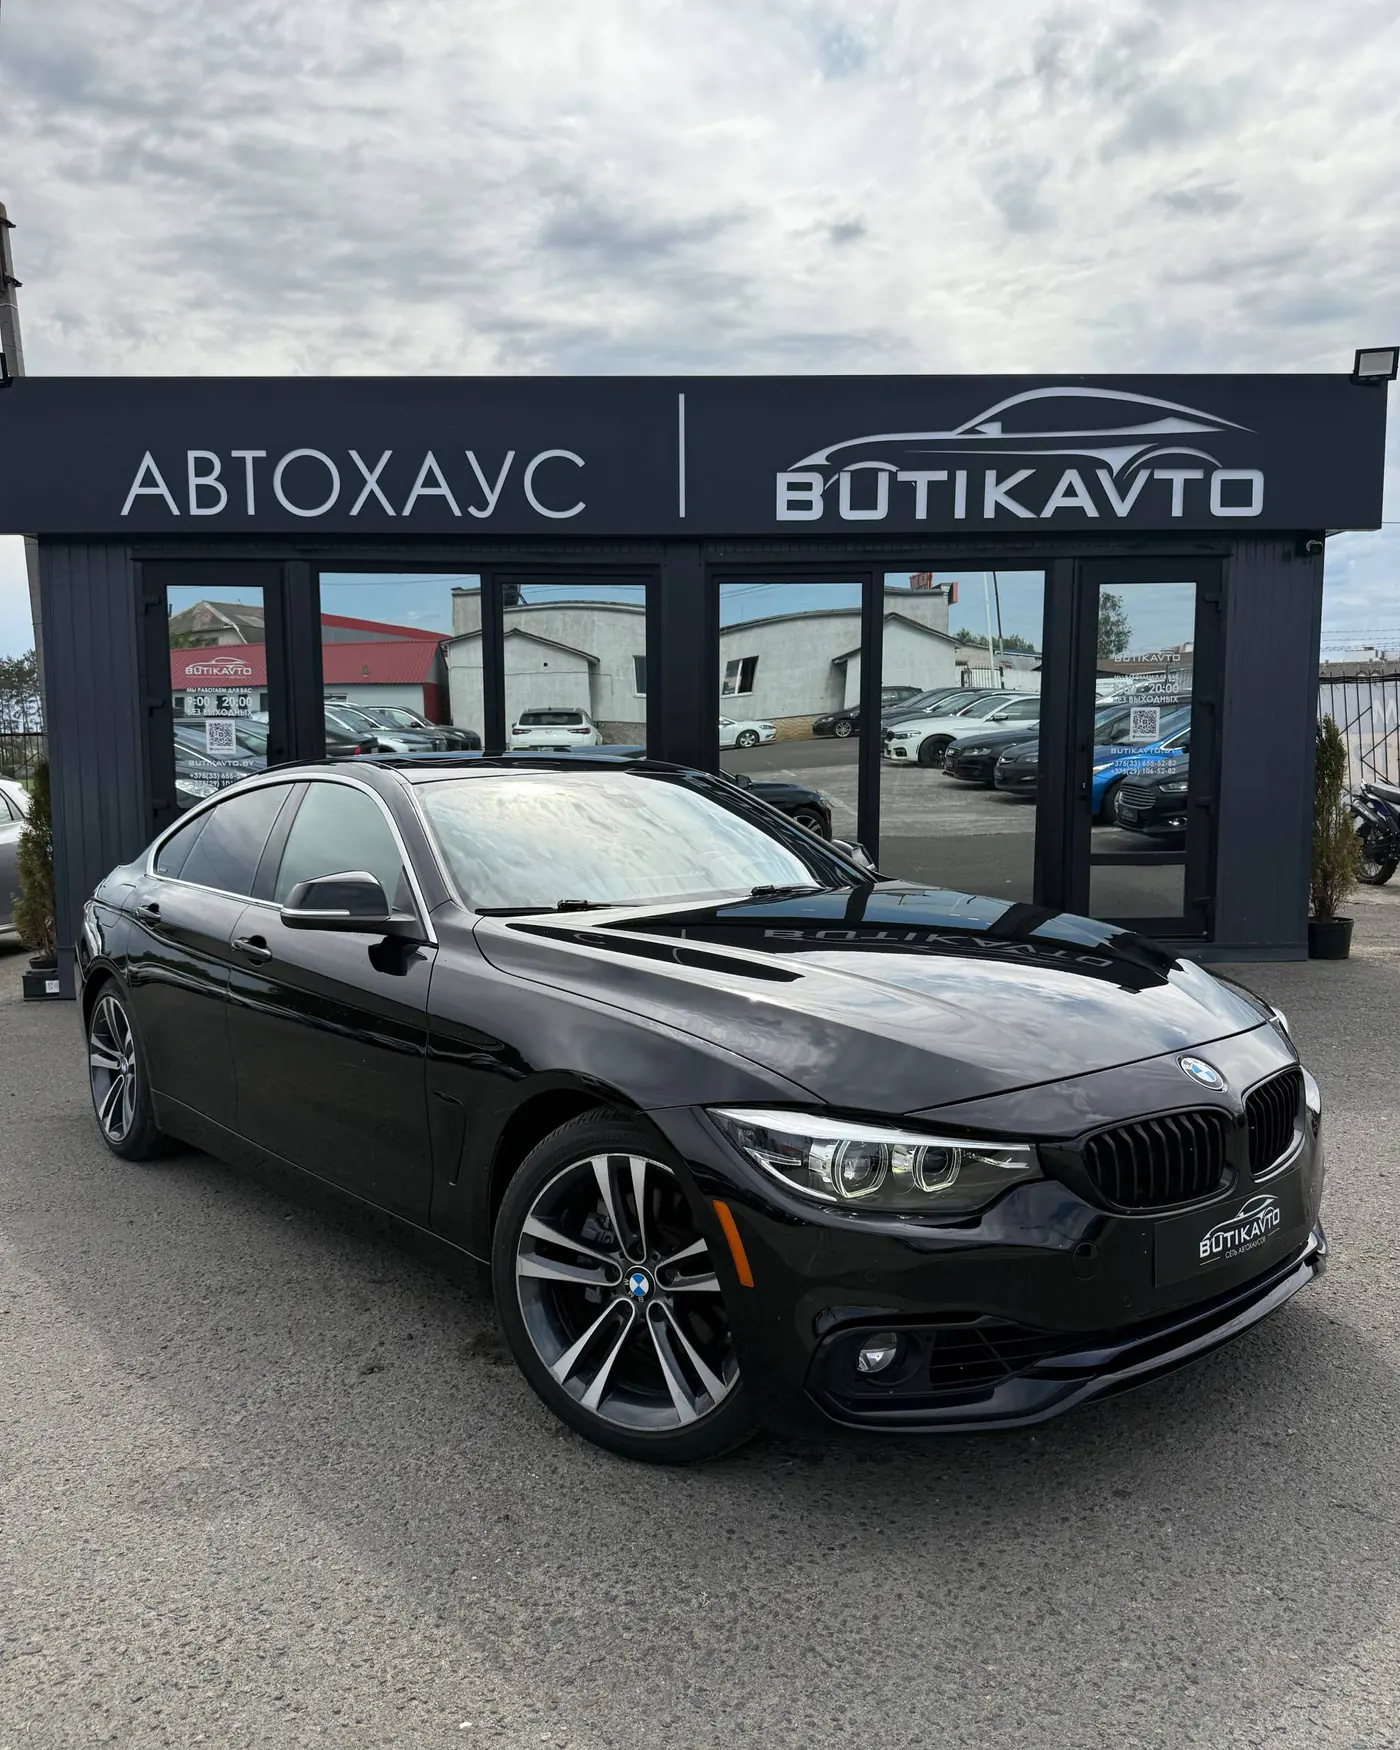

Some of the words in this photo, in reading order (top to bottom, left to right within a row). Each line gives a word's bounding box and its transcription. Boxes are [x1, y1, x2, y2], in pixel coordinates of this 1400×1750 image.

[120, 448, 587, 519] АВТОХАУС
[776, 468, 1264, 522] BUTIKAVTO
[1114, 653, 1181, 662] BUTIKAVTO
[185, 667, 252, 675] BUTIKAVTO
[1149, 683, 1180, 693] 20:00
[187, 696, 210, 707] 9:00
[222, 696, 253, 707] 20:00
[1128, 696, 1179, 704] ВЫХОДНЫХ
[187, 708, 201, 716] БЕЗ
[203, 708, 253, 717] ВЫХОДНЫХ
[189, 772, 220, 780] +375(33)
[1199, 1208, 1281, 1259] BUTIKAVTO
[1224, 1250, 1238, 1259] СЕТЬ
[1238, 1236, 1266, 1254] АВТОХАУСОВ
